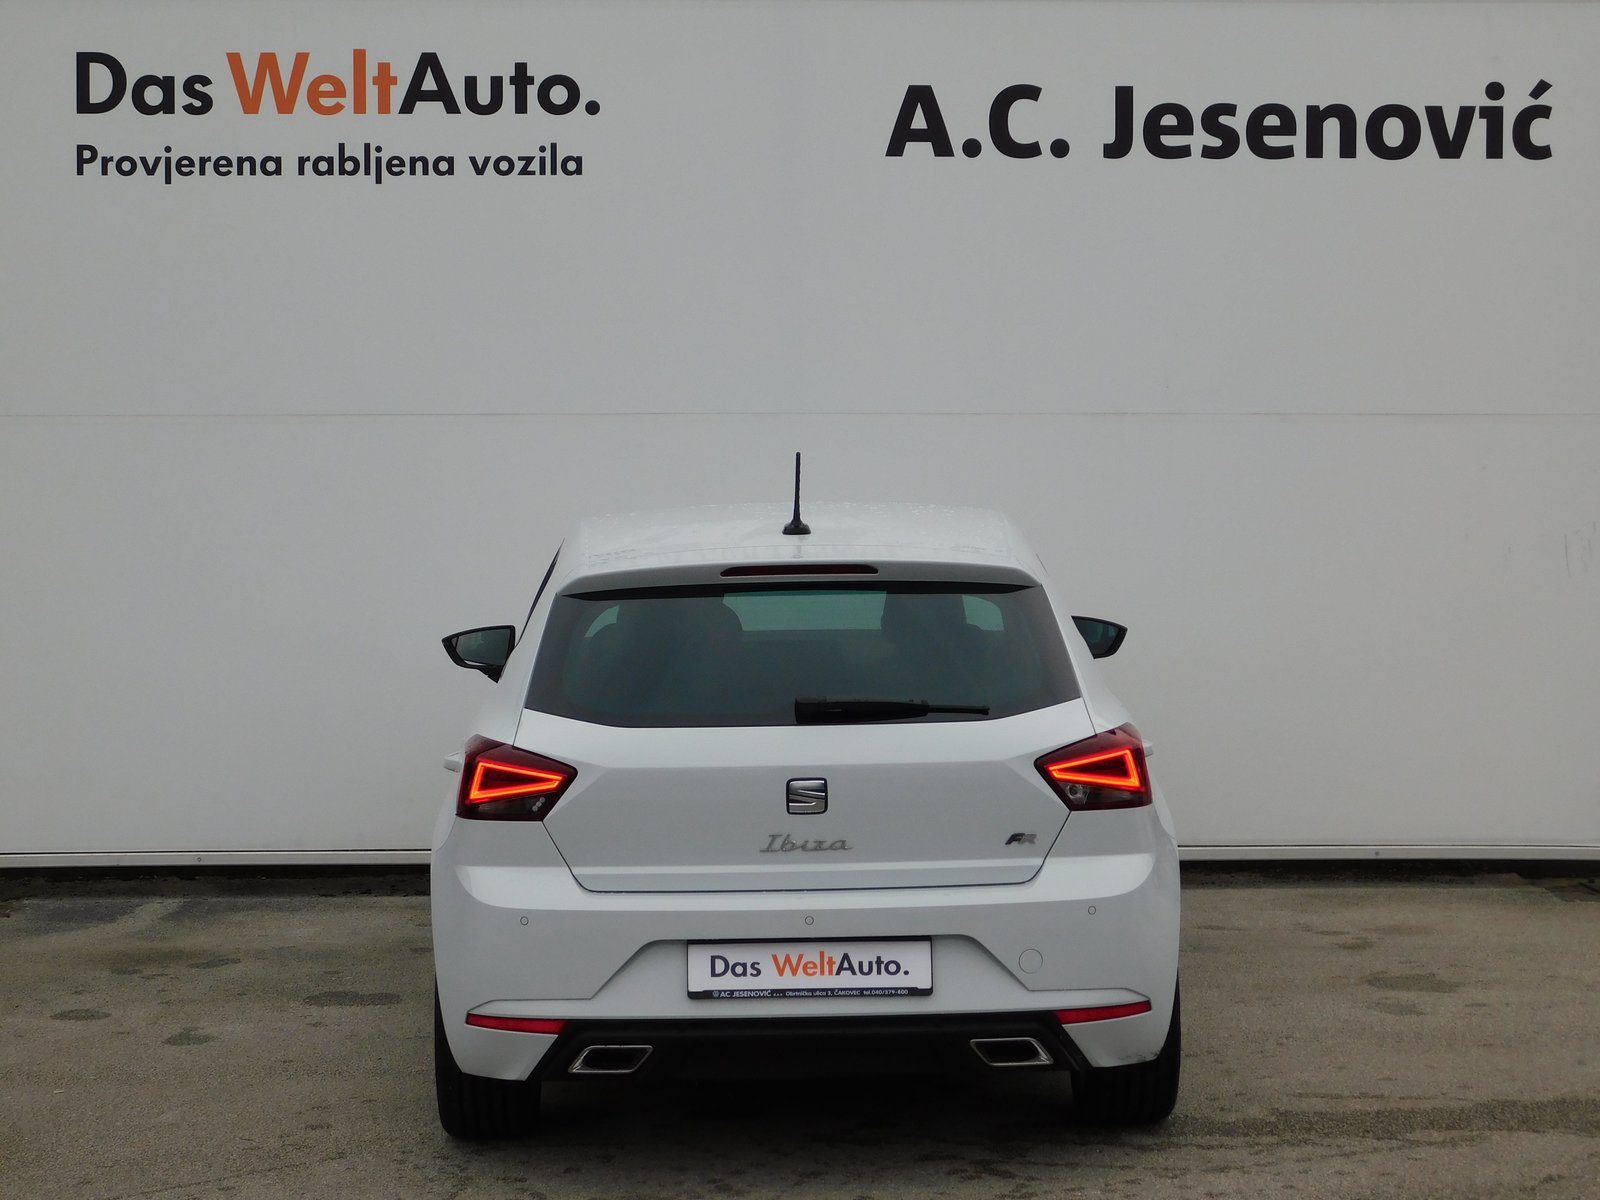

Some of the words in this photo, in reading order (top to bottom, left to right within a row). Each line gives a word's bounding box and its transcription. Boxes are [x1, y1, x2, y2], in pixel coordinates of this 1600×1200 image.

[76, 52, 213, 115] Das
[227, 48, 601, 116] WeltAuto.
[885, 84, 1070, 158] A.C.
[1103, 79, 1553, 160] Jesenović
[77, 145, 282, 184] Provjerena
[298, 143, 455, 184] rabljena
[469, 143, 583, 177] vozila
[759, 834, 852, 853] Ibiza
[1005, 832, 1037, 846] FR
[710, 955, 762, 978] Das
[772, 950, 910, 977] WeltAuto.
[733, 989, 772, 998] JESENOVIĆ
